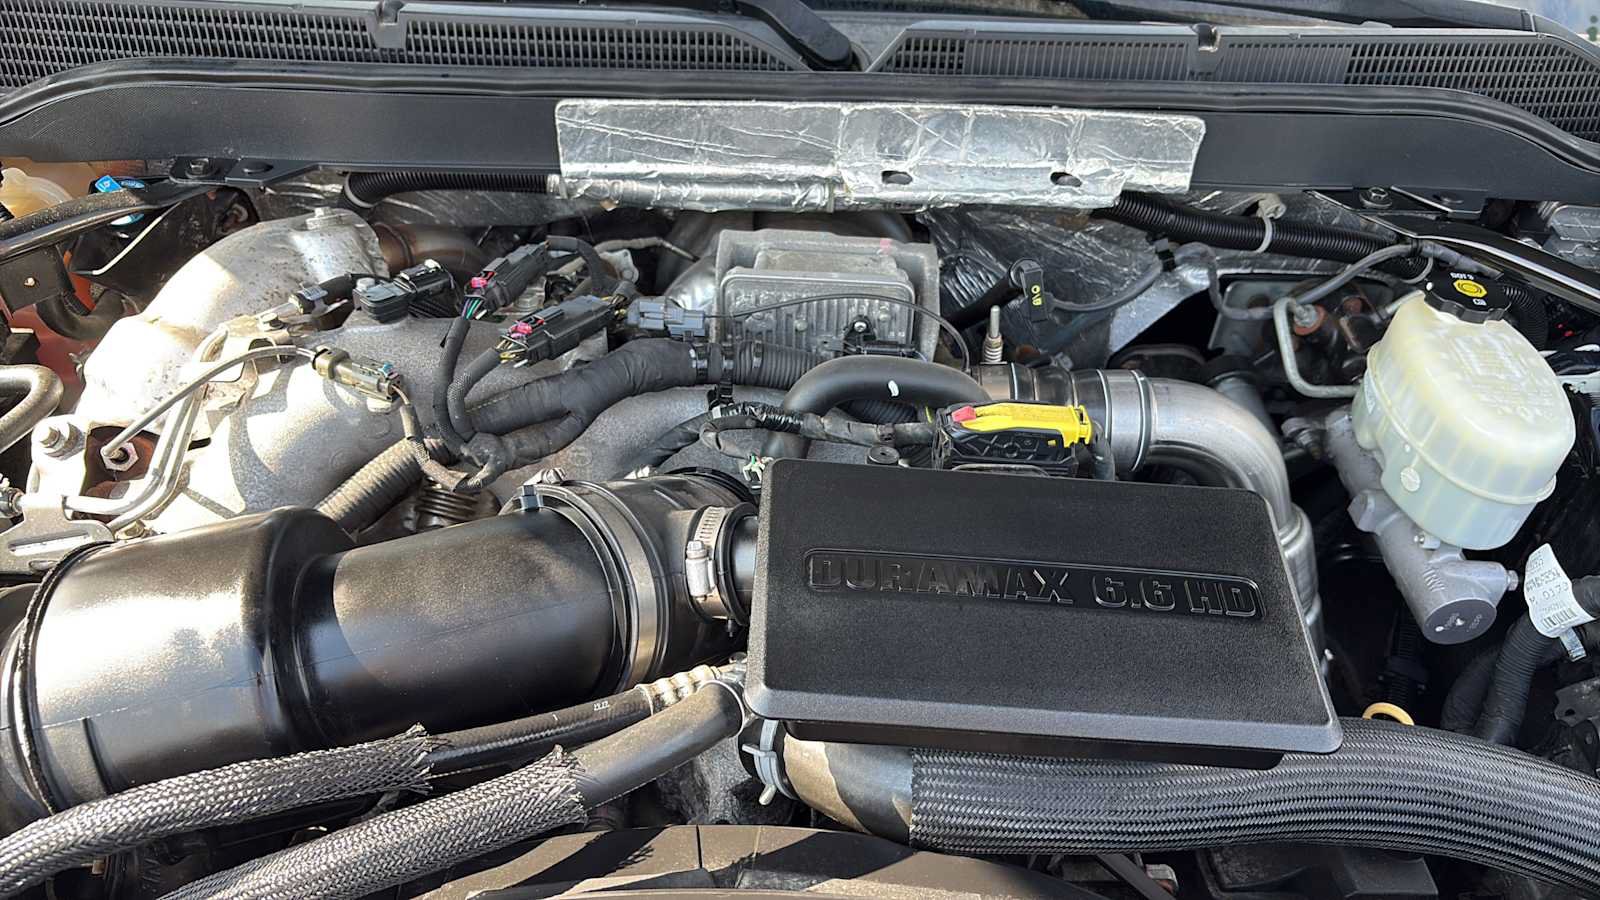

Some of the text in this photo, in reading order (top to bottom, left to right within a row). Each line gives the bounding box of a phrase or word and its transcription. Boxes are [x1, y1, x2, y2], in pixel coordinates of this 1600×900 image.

[808, 557, 1258, 617] DURAMAX 6.6 HD
